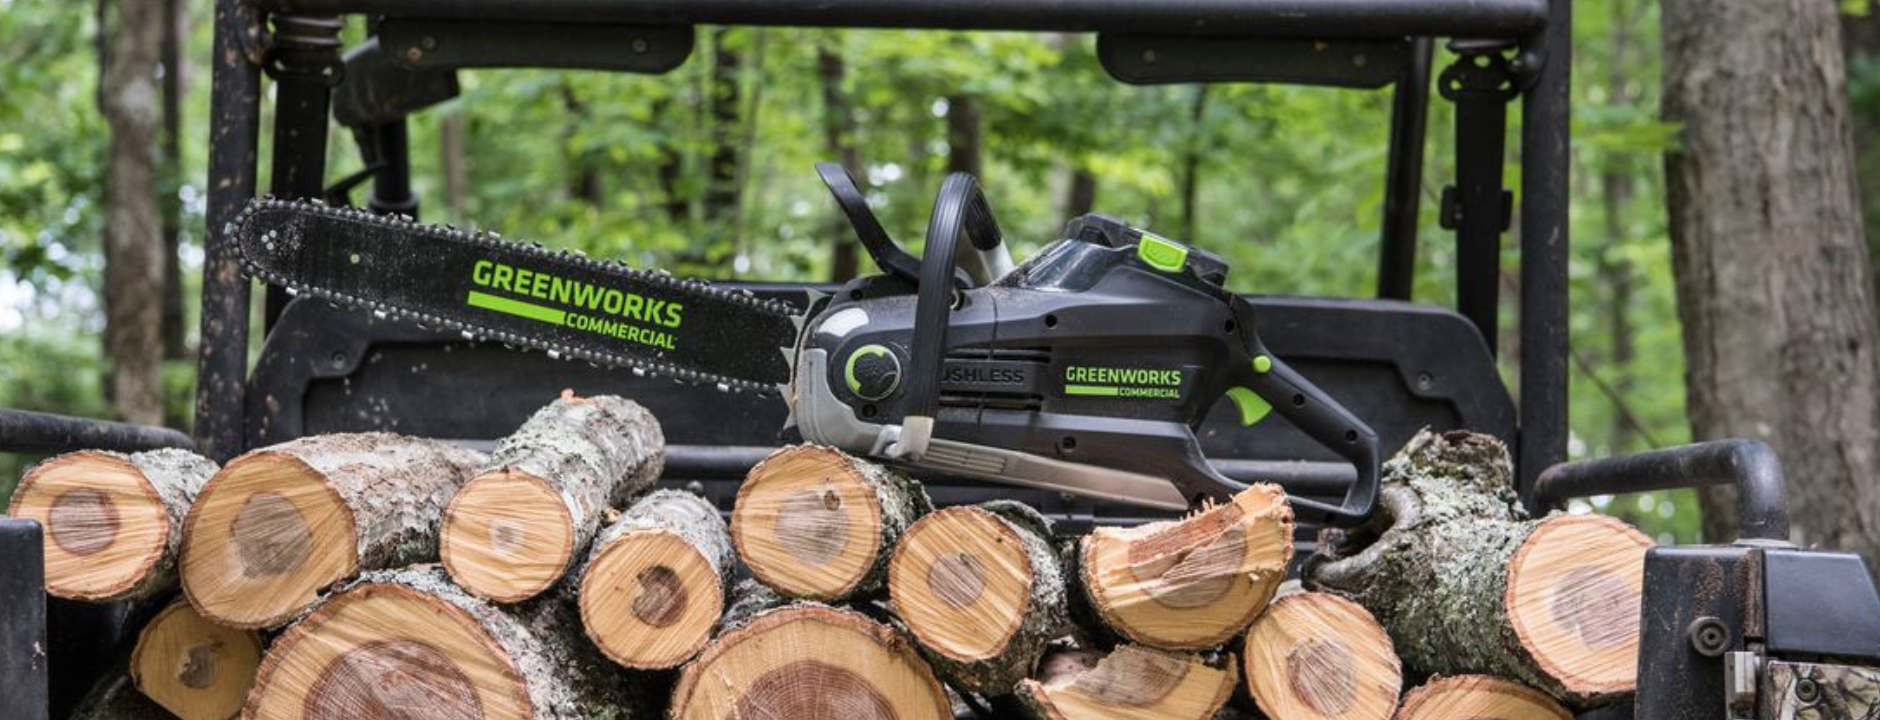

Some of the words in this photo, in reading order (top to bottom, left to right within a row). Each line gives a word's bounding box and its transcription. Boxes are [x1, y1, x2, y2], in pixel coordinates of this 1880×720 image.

[472, 260, 683, 328] GREENWORKS
[565, 312, 676, 350] COMMERCIAL
[1065, 366, 1181, 386] GREENWORKS
[1119, 387, 1180, 398] COMMERCIAL
